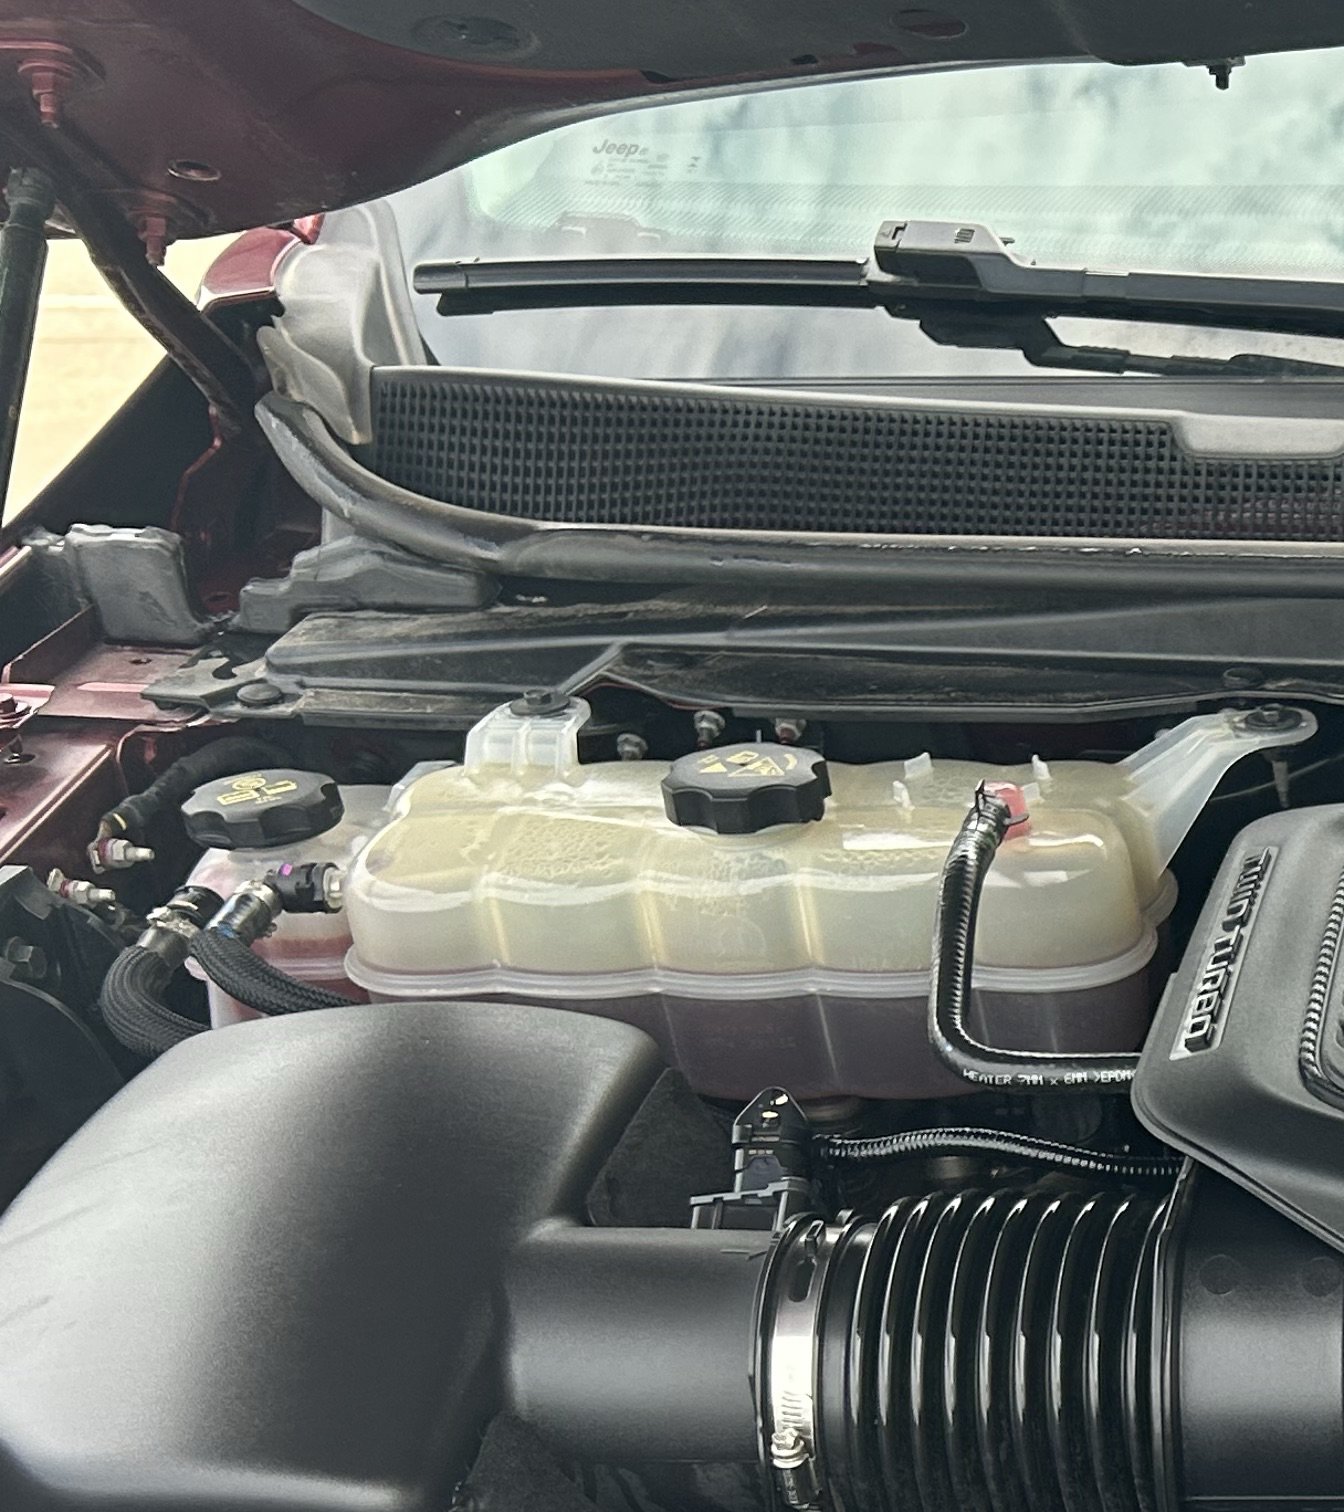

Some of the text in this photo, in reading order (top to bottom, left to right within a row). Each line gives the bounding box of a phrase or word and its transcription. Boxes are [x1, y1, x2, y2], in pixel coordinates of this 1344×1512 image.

[592, 139, 640, 157] Jeep
[1186, 848, 1271, 1049] TWIN TURBO
[963, 1068, 1011, 1085] HEATER
[1064, 1072, 1088, 1084] 6MM
